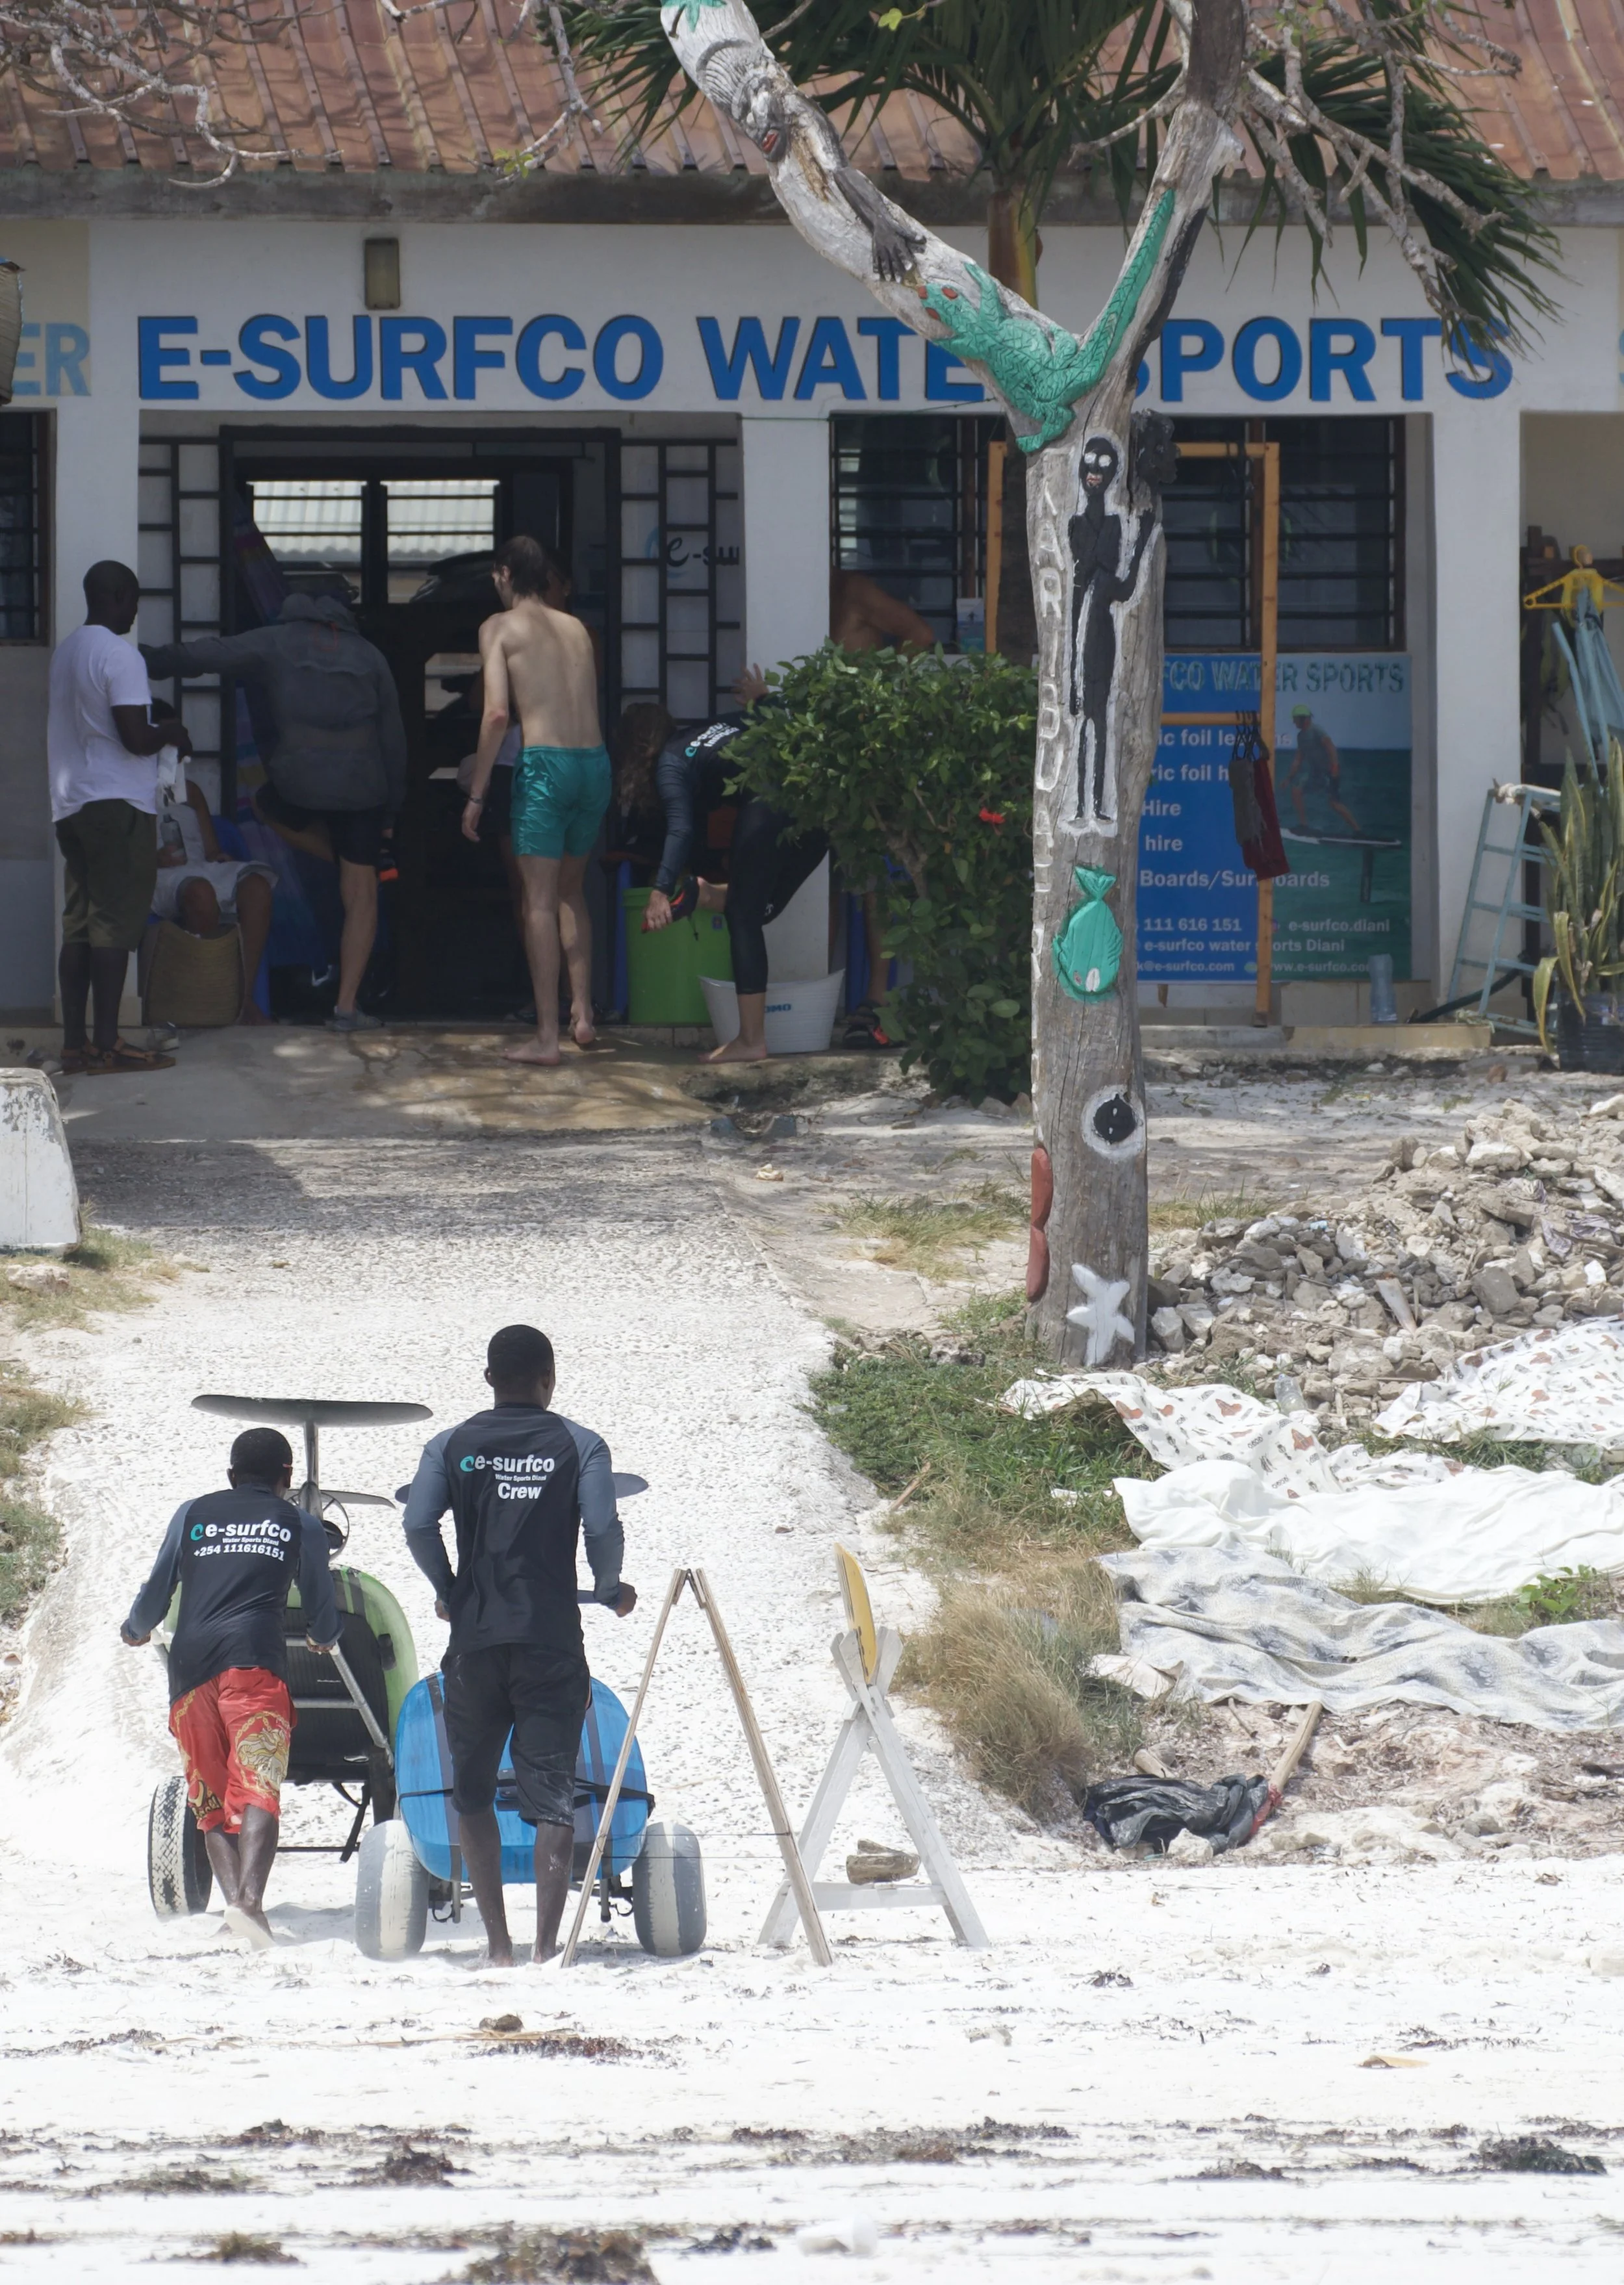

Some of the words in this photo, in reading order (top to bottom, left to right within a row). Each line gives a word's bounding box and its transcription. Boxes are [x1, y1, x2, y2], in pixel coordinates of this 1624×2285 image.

[138, 314, 663, 400] E-SURFCO
[696, 316, 985, 401] WATE
[1135, 316, 1513, 402] PORTS
[1306, 662, 1404, 693] SPORTS
[1181, 729, 1212, 746] foil
[1180, 764, 1212, 781] foil
[1141, 800, 1182, 817] Hire
[1145, 835, 1183, 852] hire
[1144, 918, 1174, 932] 111
[1178, 918, 1208, 932] 616
[1212, 918, 1242, 932] 151
[1288, 918, 1390, 932] e-surfco.diani
[1144, 939, 1204, 952] e-surfco
[1209, 940, 1252, 952] water
[1306, 938, 1345, 952] Diani
[1271, 962, 1369, 973] ww.e-surfco.co
[476, 1454, 555, 1473] e-surfco
[498, 1482, 542, 1500] Crew
[205, 1519, 292, 1542] e-surfco
[262, 1538, 279, 1546] Diani
[194, 1544, 222, 1557] +254
[223, 1544, 285, 1561] 111616151
